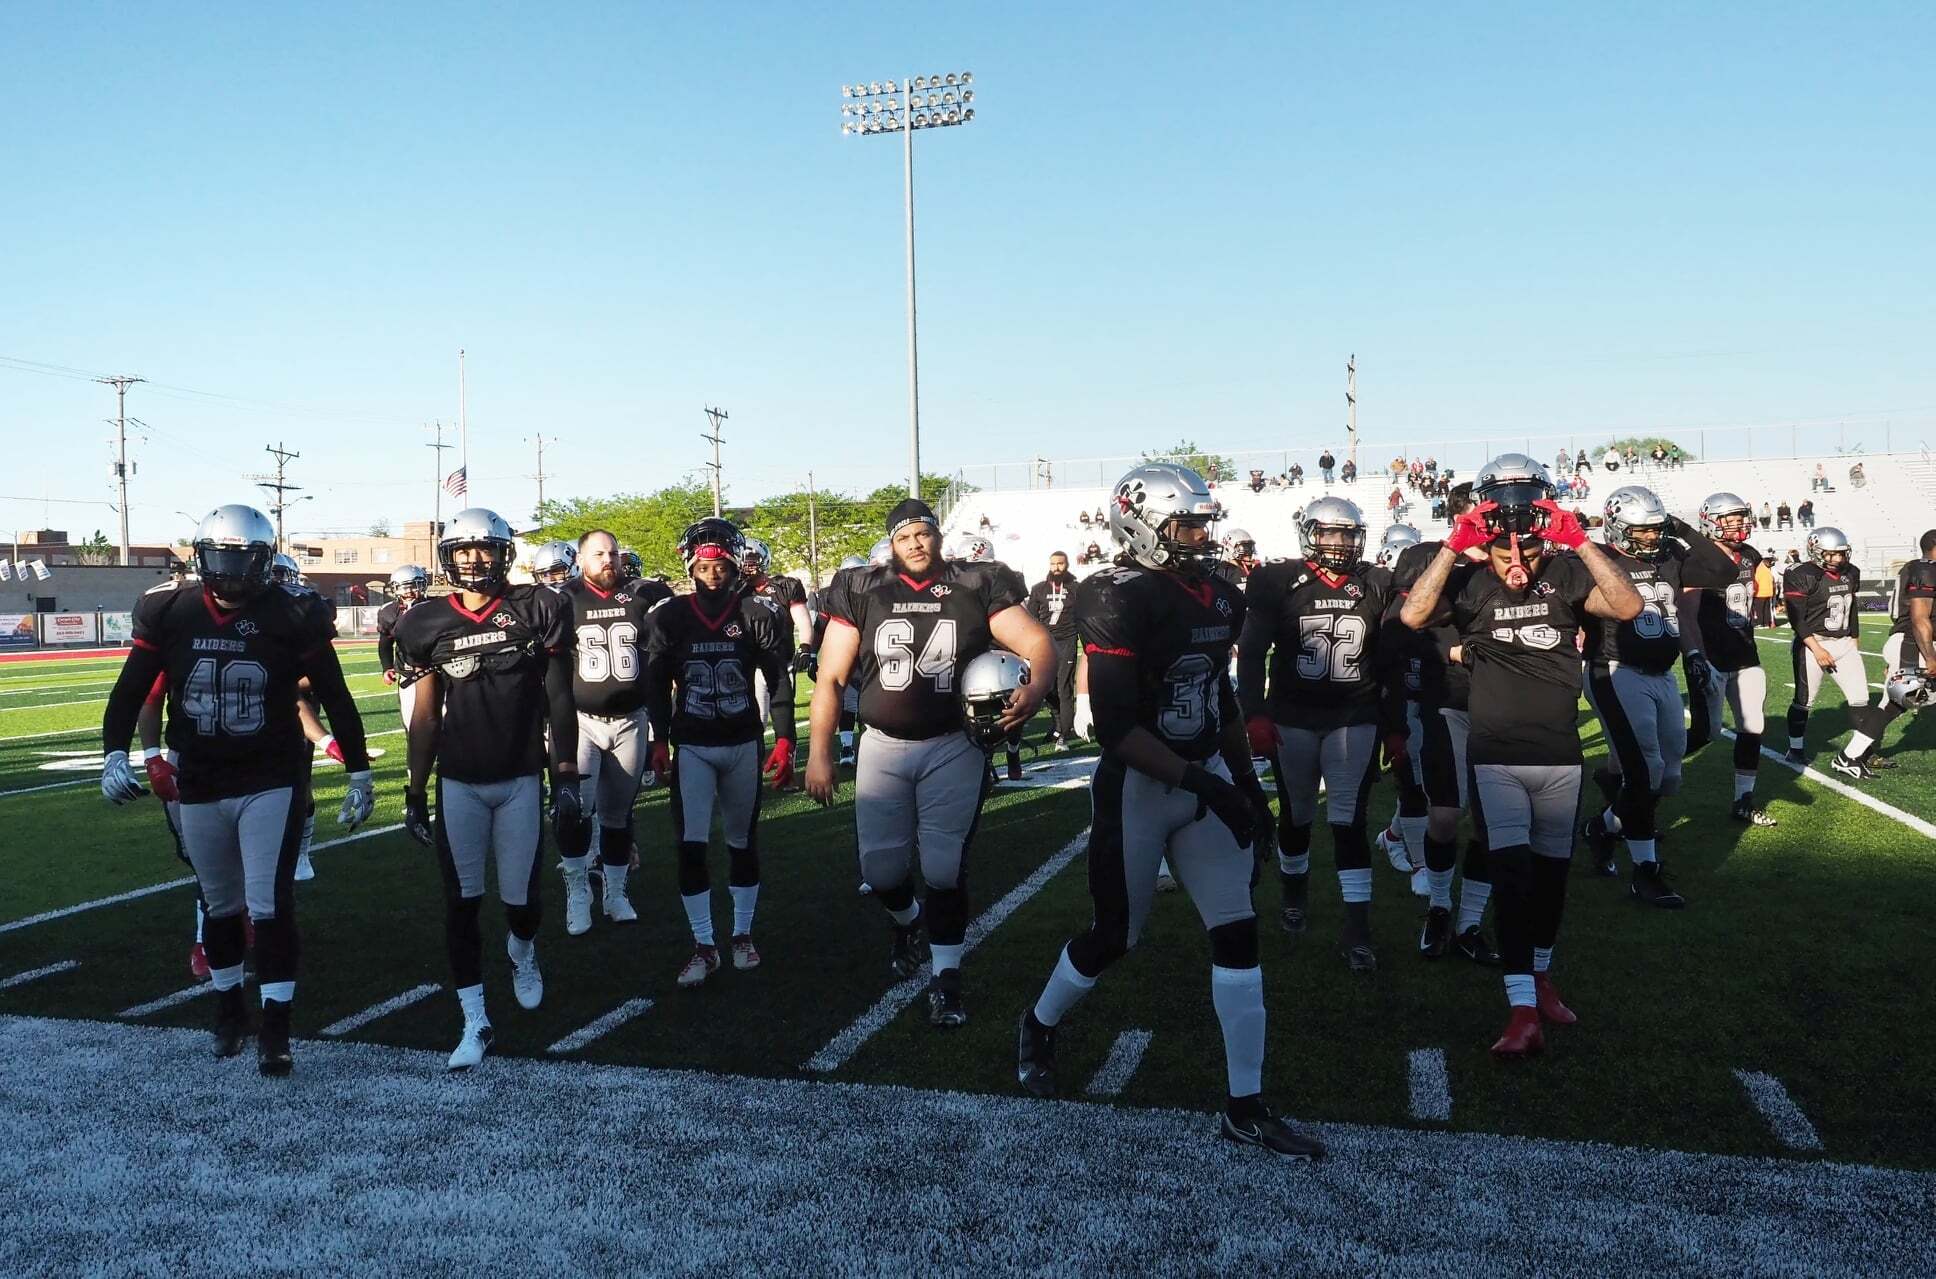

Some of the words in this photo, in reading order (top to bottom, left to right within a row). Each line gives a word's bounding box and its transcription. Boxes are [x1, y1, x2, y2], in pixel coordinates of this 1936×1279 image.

[586, 607, 626, 620] RAIDERS
[893, 602, 942, 613] RAIDERS
[1314, 600, 1357, 609] RAIDER
[191, 637, 246, 652] RAIDERS
[453, 630, 507, 651] RAIDERS
[576, 622, 640, 682] 66
[874, 618, 957, 693] 64
[1296, 614, 1367, 682] 52
[182, 657, 268, 736] 40
[682, 658, 750, 719] 29
